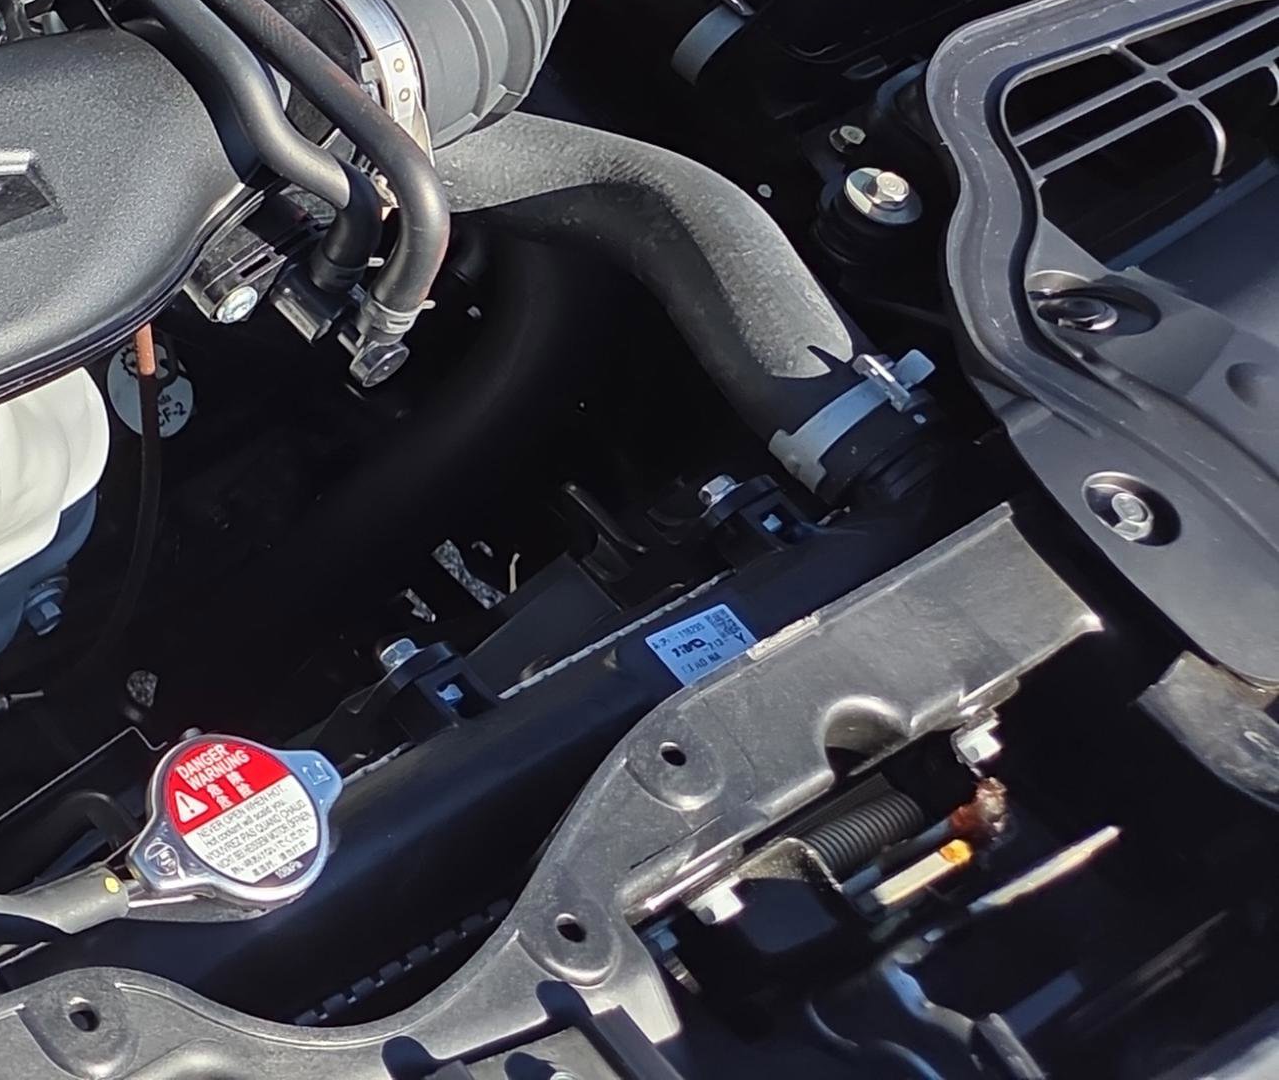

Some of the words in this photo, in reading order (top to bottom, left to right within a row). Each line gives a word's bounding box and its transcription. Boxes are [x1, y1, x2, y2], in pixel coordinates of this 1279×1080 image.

[175, 743, 228, 780] DANGER
[186, 749, 251, 791] WARNUNG
[196, 819, 225, 839] NEVER
[222, 806, 247, 824] OPEN
[244, 793, 270, 812] WHEN
[203, 835, 219, 848] Hot
[216, 821, 243, 841] coolant
[240, 815, 254, 827] will
[239, 827, 257, 842] PAS
[254, 813, 282, 833] QUAND
